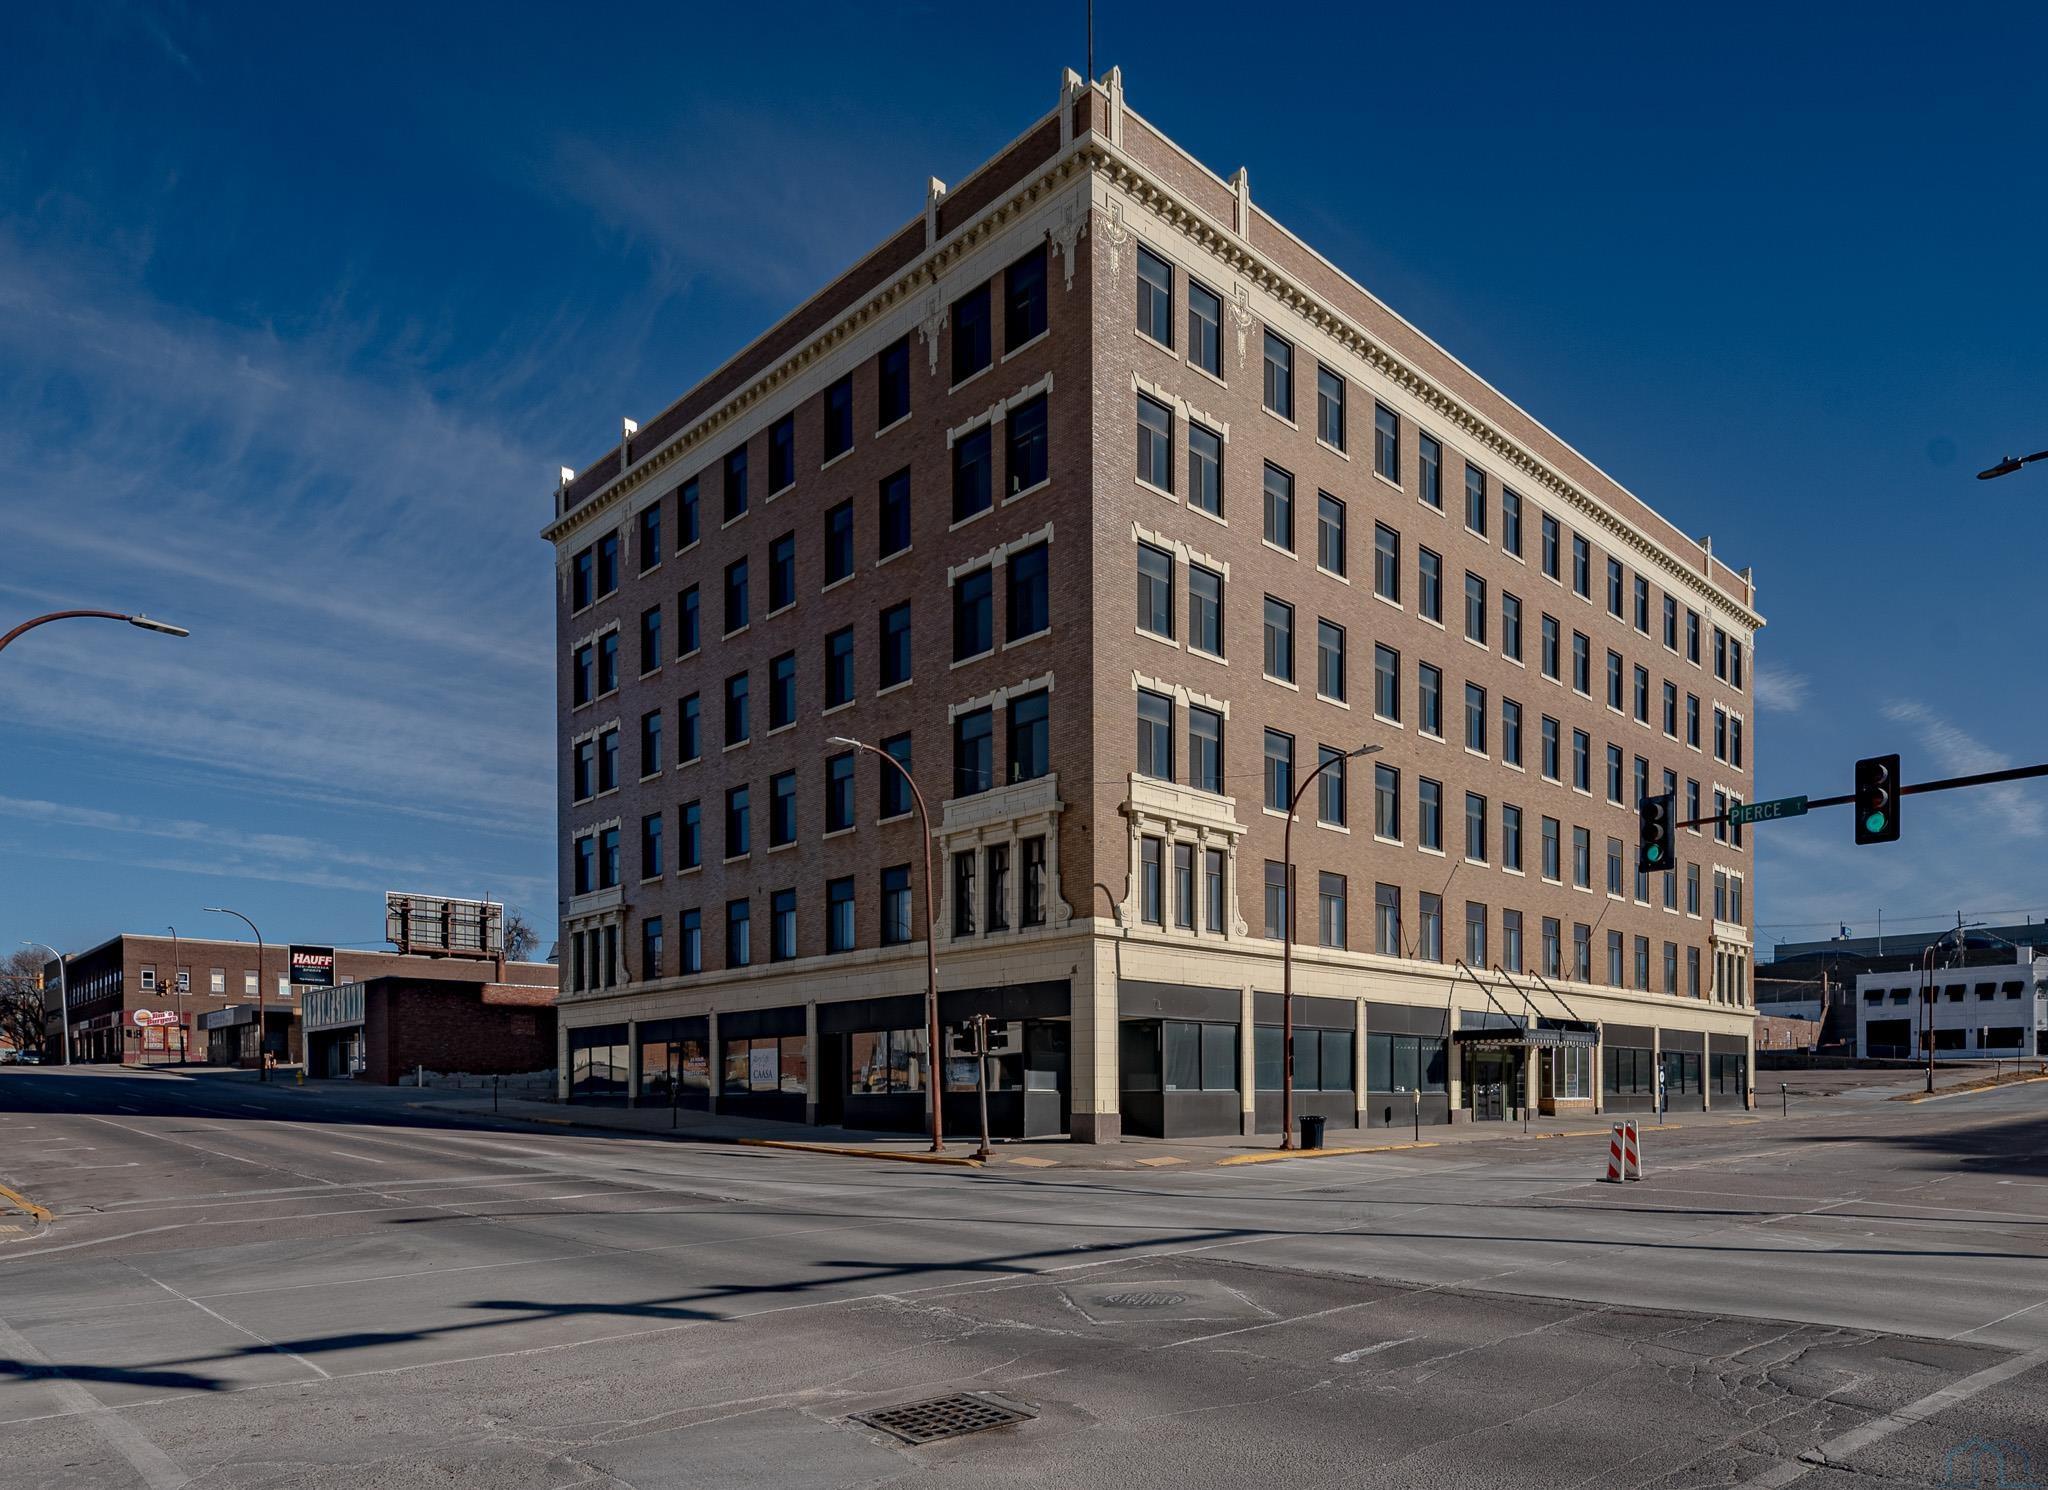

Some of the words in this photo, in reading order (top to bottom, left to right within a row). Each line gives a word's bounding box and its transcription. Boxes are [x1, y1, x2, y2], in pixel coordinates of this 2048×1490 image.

[1731, 803, 1781, 823] PIERCE
[293, 953, 332, 965] HAUFF
[147, 1016, 177, 1024] Burgers
[753, 1069, 773, 1079] CAASA
